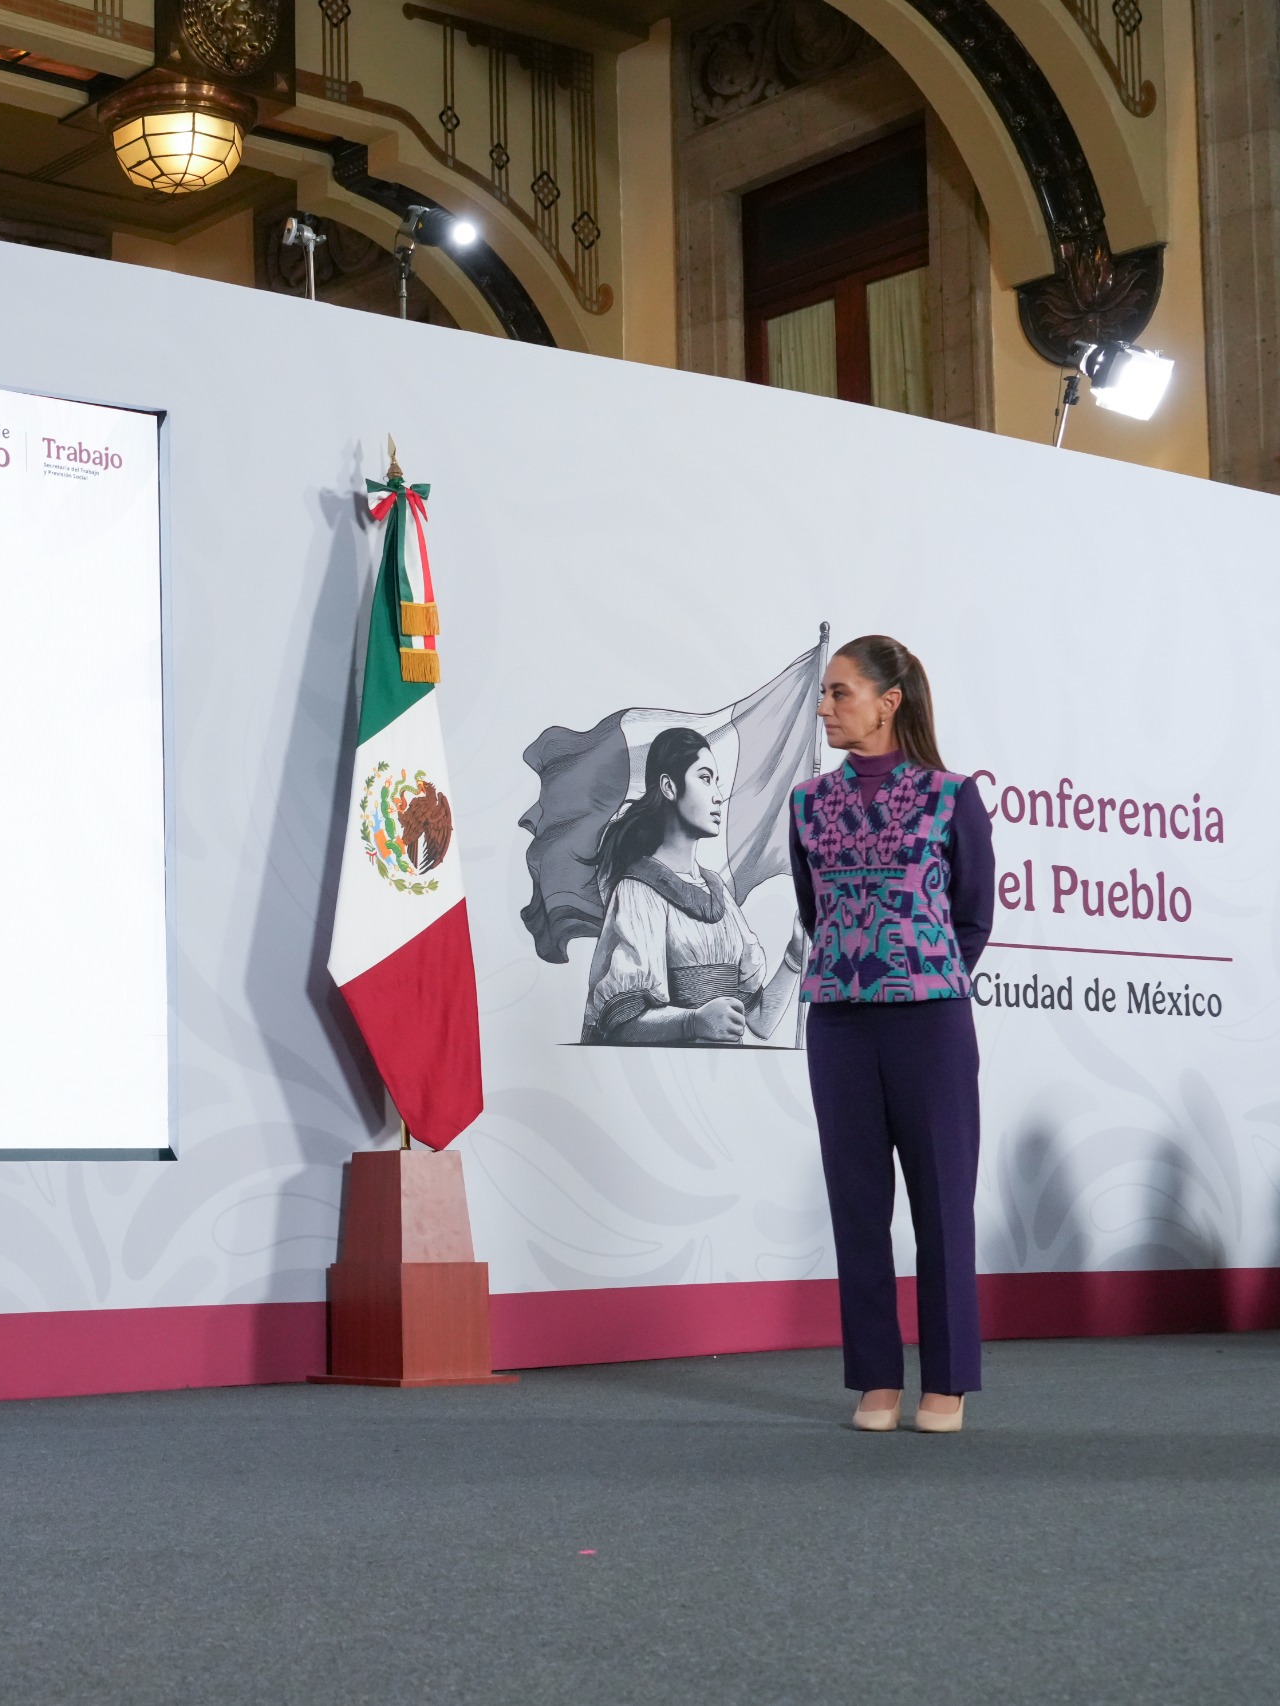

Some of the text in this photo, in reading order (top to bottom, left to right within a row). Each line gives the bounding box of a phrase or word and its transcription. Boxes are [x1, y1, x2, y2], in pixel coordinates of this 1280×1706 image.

[42, 437, 123, 470] Trabajo
[998, 859, 1192, 923] el Pueblo
[972, 972, 1223, 1018] Ciudad de México
